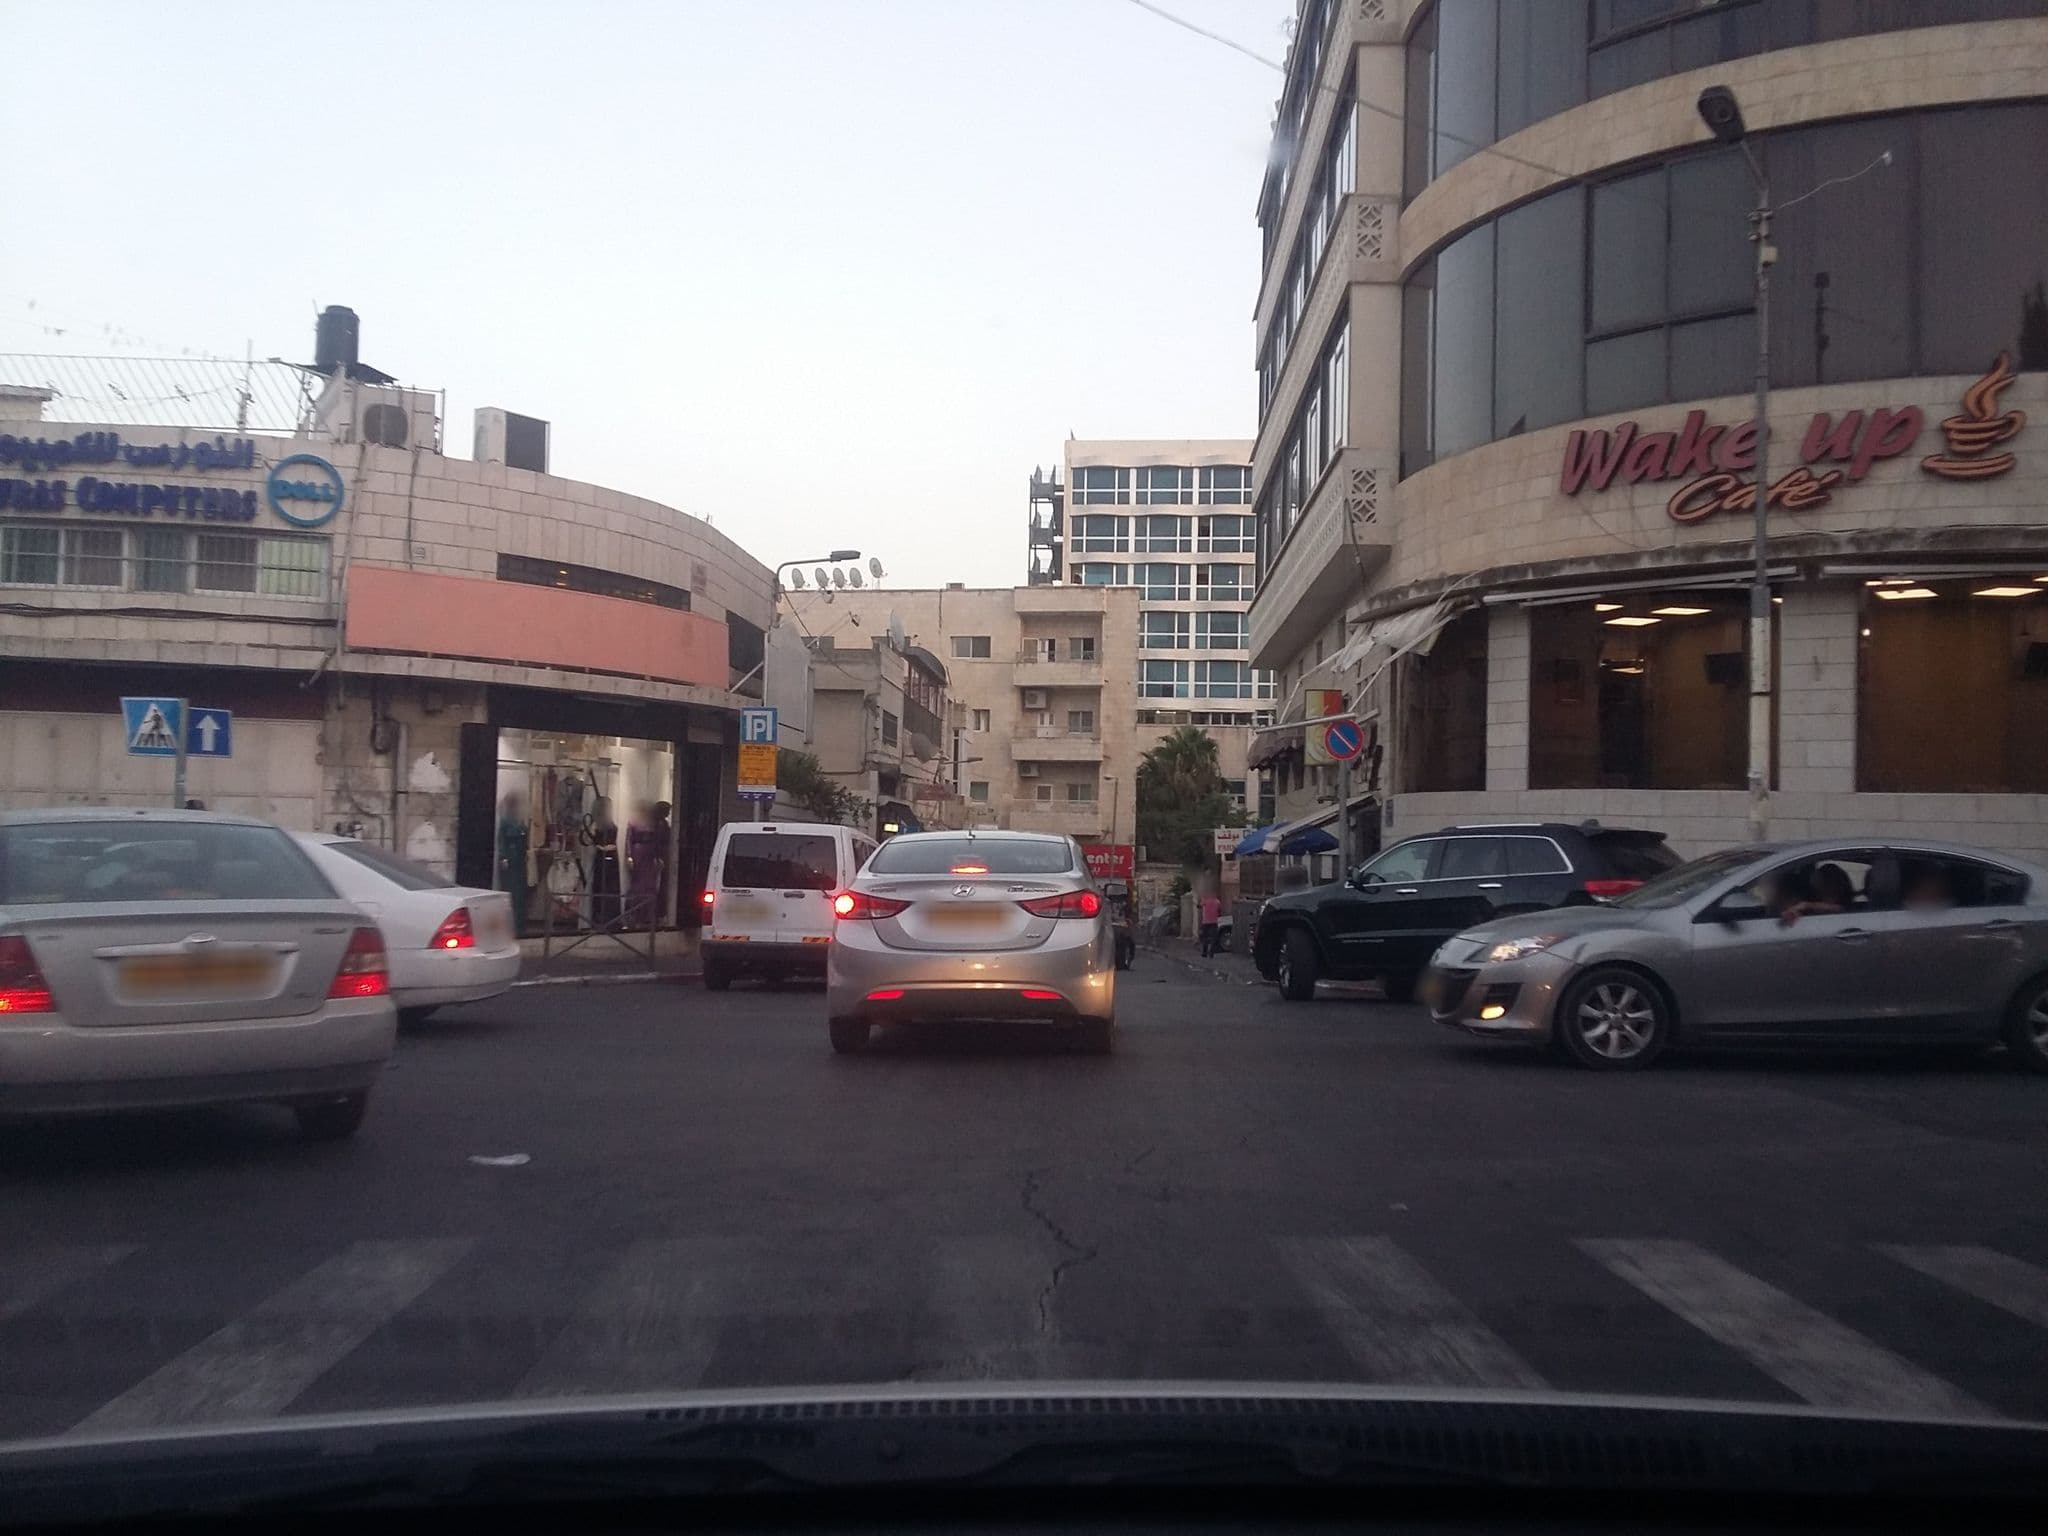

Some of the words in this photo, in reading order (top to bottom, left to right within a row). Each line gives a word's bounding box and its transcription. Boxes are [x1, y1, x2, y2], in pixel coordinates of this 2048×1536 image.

[1561, 408, 1770, 495] Wake
[1801, 404, 1926, 481] up
[1667, 467, 1843, 523] Café
